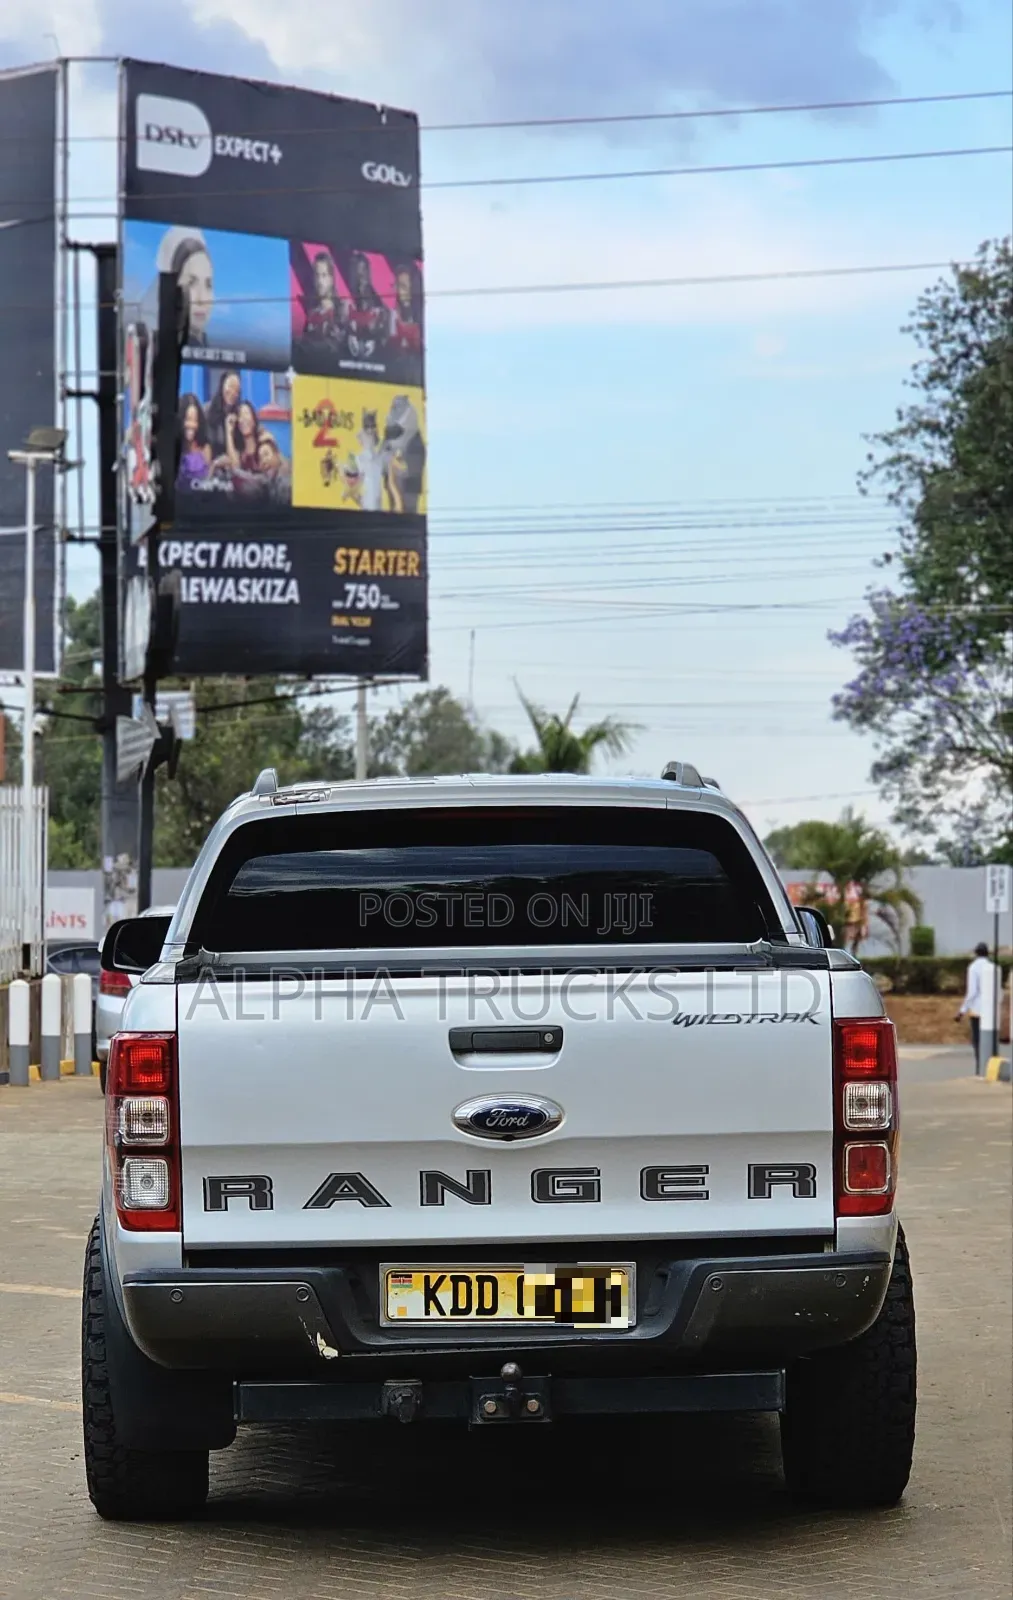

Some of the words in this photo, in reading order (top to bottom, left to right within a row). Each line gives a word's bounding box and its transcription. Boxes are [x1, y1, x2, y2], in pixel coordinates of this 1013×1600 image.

[145, 122, 202, 150] DStv
[361, 160, 412, 187] GOtv
[222, 541, 292, 573] MORE,
[333, 547, 420, 577] STARTER
[344, 582, 381, 610] 750
[46, 910, 87, 929] INTS
[672, 1011, 824, 1028] WILDTRAK
[485, 1107, 532, 1127] Ford
[203, 1163, 818, 1212] RANGER
[423, 1274, 499, 1316] KDD
